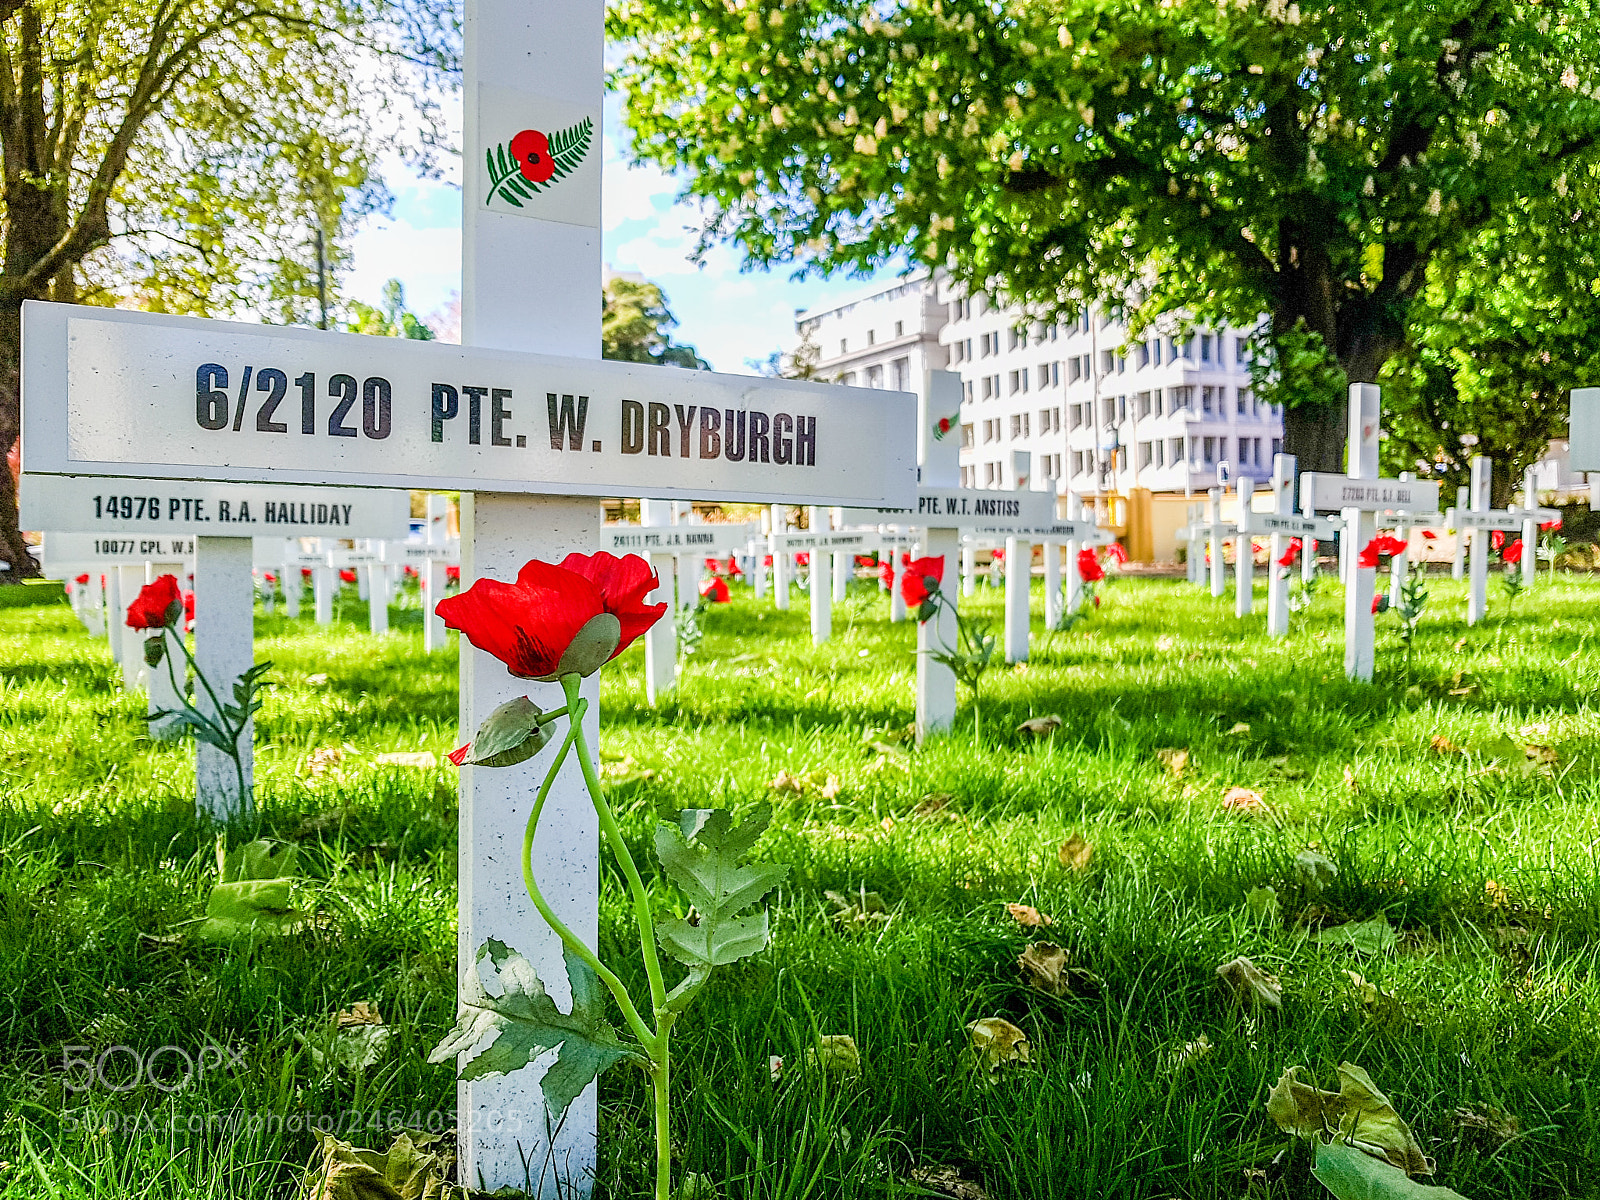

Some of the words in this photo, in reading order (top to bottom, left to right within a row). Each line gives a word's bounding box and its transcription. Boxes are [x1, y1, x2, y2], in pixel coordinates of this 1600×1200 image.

[195, 362, 392, 441] 6/2120
[431, 382, 526, 449] PTE.
[546, 392, 602, 454] W.
[621, 399, 817, 467] DRYBURGH
[93, 495, 160, 521] 14976
[169, 498, 211, 522] PTE.
[219, 500, 257, 523] R.A.
[265, 501, 352, 526] HALLIDAY
[918, 497, 942, 514] PTE.
[946, 498, 970, 515] W.T.
[974, 499, 1020, 517] ANSTISS
[95, 540, 135, 554] 10077
[140, 540, 167, 555] CPL.
